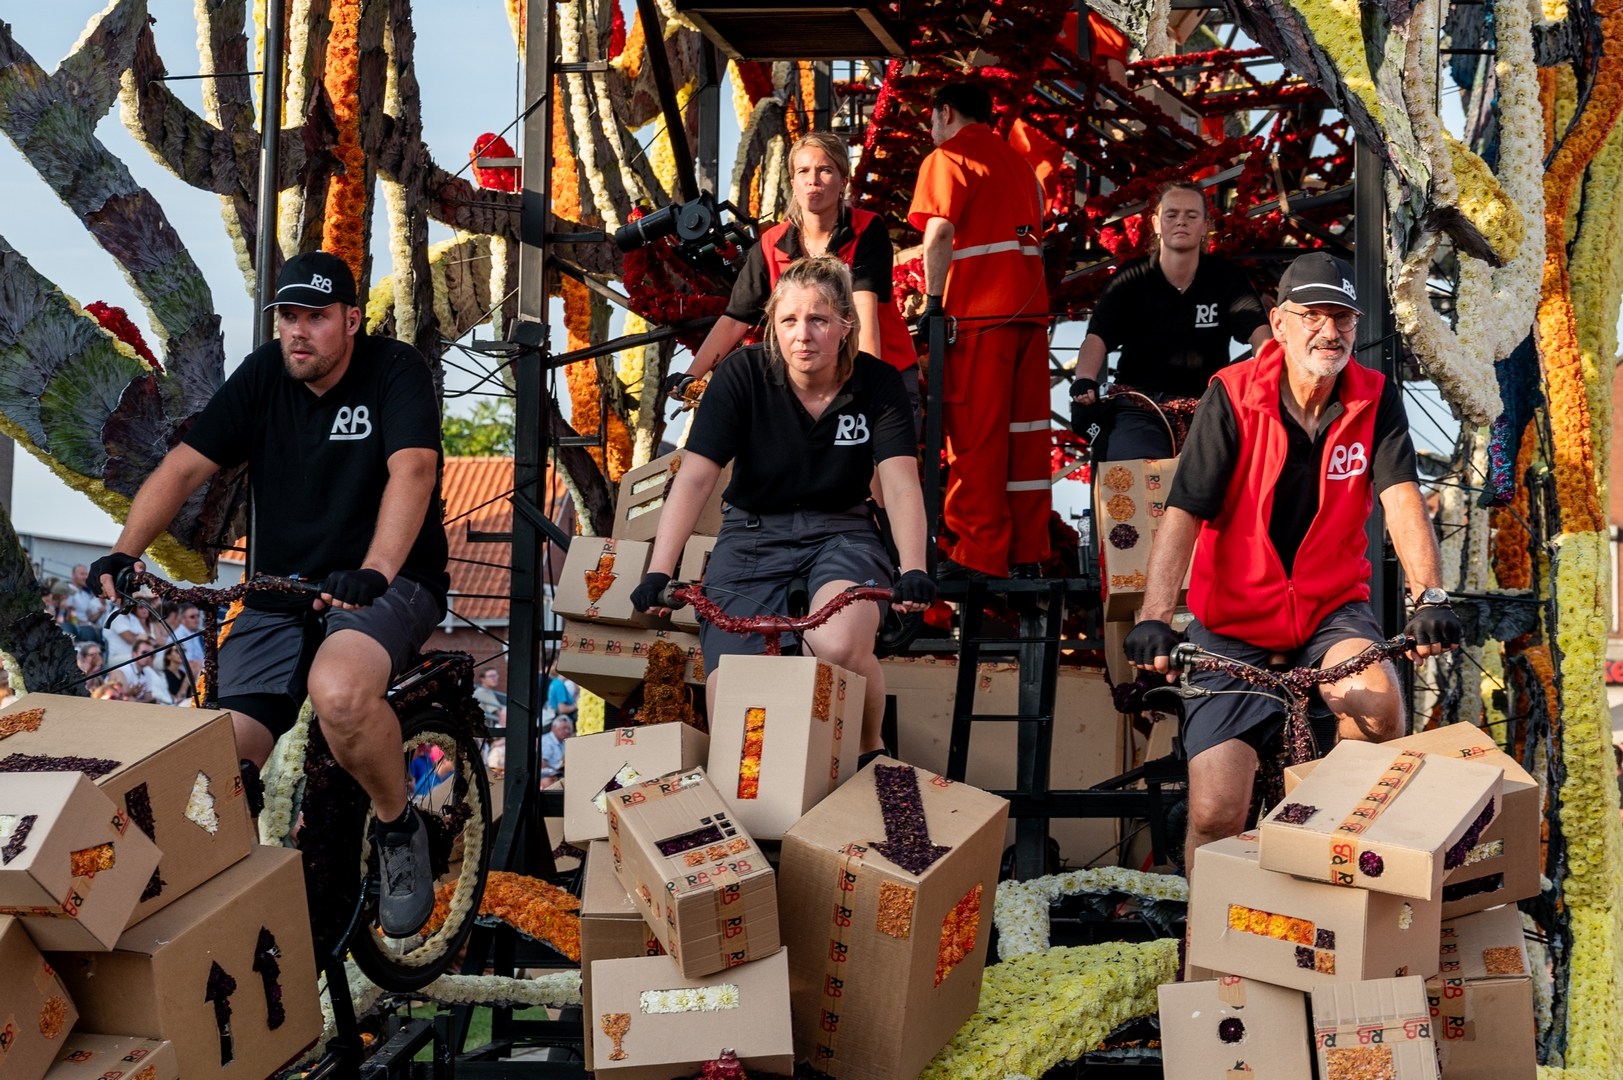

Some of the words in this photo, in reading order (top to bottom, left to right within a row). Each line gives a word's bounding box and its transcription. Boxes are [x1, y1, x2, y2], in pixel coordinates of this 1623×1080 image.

[311, 274, 332, 294] RB
[329, 406, 373, 440] RB
[834, 413, 870, 446] RB
[1086, 423, 1101, 446] RB
[1327, 442, 1368, 480] RB
[1145, 475, 1161, 491] RB
[1149, 502, 1164, 518] RB
[578, 638, 595, 653] RB
[605, 640, 622, 655] RB
[632, 642, 649, 657] RB
[1459, 746, 1486, 761] RB
[620, 792, 646, 807] RB
[1339, 822, 1363, 834] RB
[1352, 808, 1376, 820] RB
[1366, 793, 1389, 805] RB
[1378, 778, 1401, 789] RB
[1390, 763, 1413, 774] RB
[1332, 844, 1353, 865] RB
[686, 872, 711, 889] RB
[840, 868, 856, 892] RB
[1333, 870, 1354, 886] R
[721, 882, 740, 906] RB
[835, 904, 852, 927] RB
[723, 916, 743, 939] RB
[831, 940, 848, 963] RB
[1440, 944, 1457, 955] RB
[726, 950, 745, 970] R
[1440, 961, 1460, 973] RB
[826, 974, 844, 998] RB
[1443, 978, 1463, 999] RB
[822, 1009, 839, 1033] RB
[1403, 1019, 1430, 1038] RB
[1444, 1016, 1465, 1039] RB
[1356, 1025, 1384, 1044] RB
[121, 1050, 149, 1064] RB
[817, 1044, 834, 1061] R
